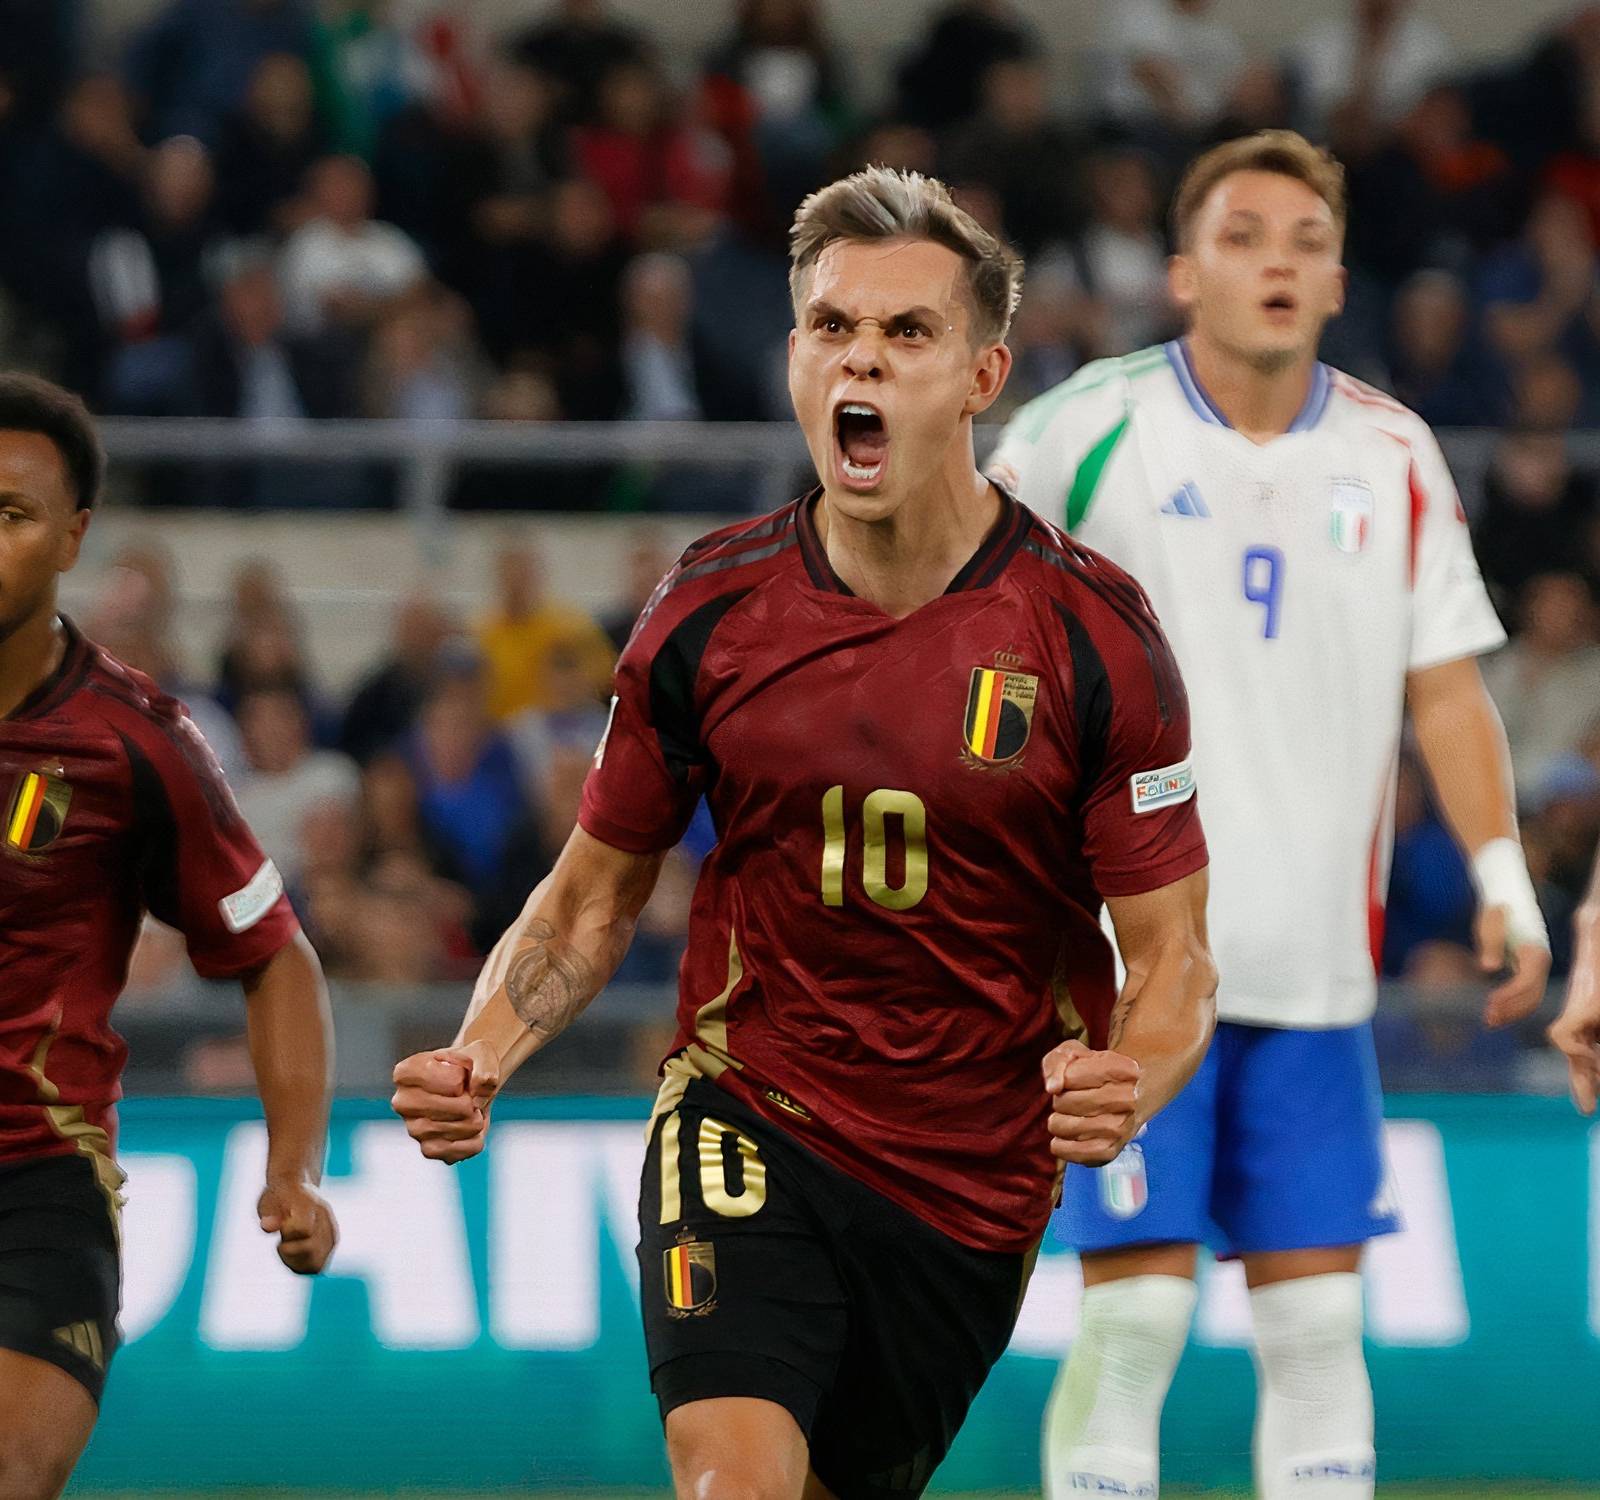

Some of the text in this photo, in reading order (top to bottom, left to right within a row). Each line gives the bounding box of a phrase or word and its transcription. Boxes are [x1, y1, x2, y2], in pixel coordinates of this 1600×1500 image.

[1243, 543, 1285, 639] 9
[821, 785, 929, 911] 10
[660, 1110, 767, 1225] 10
